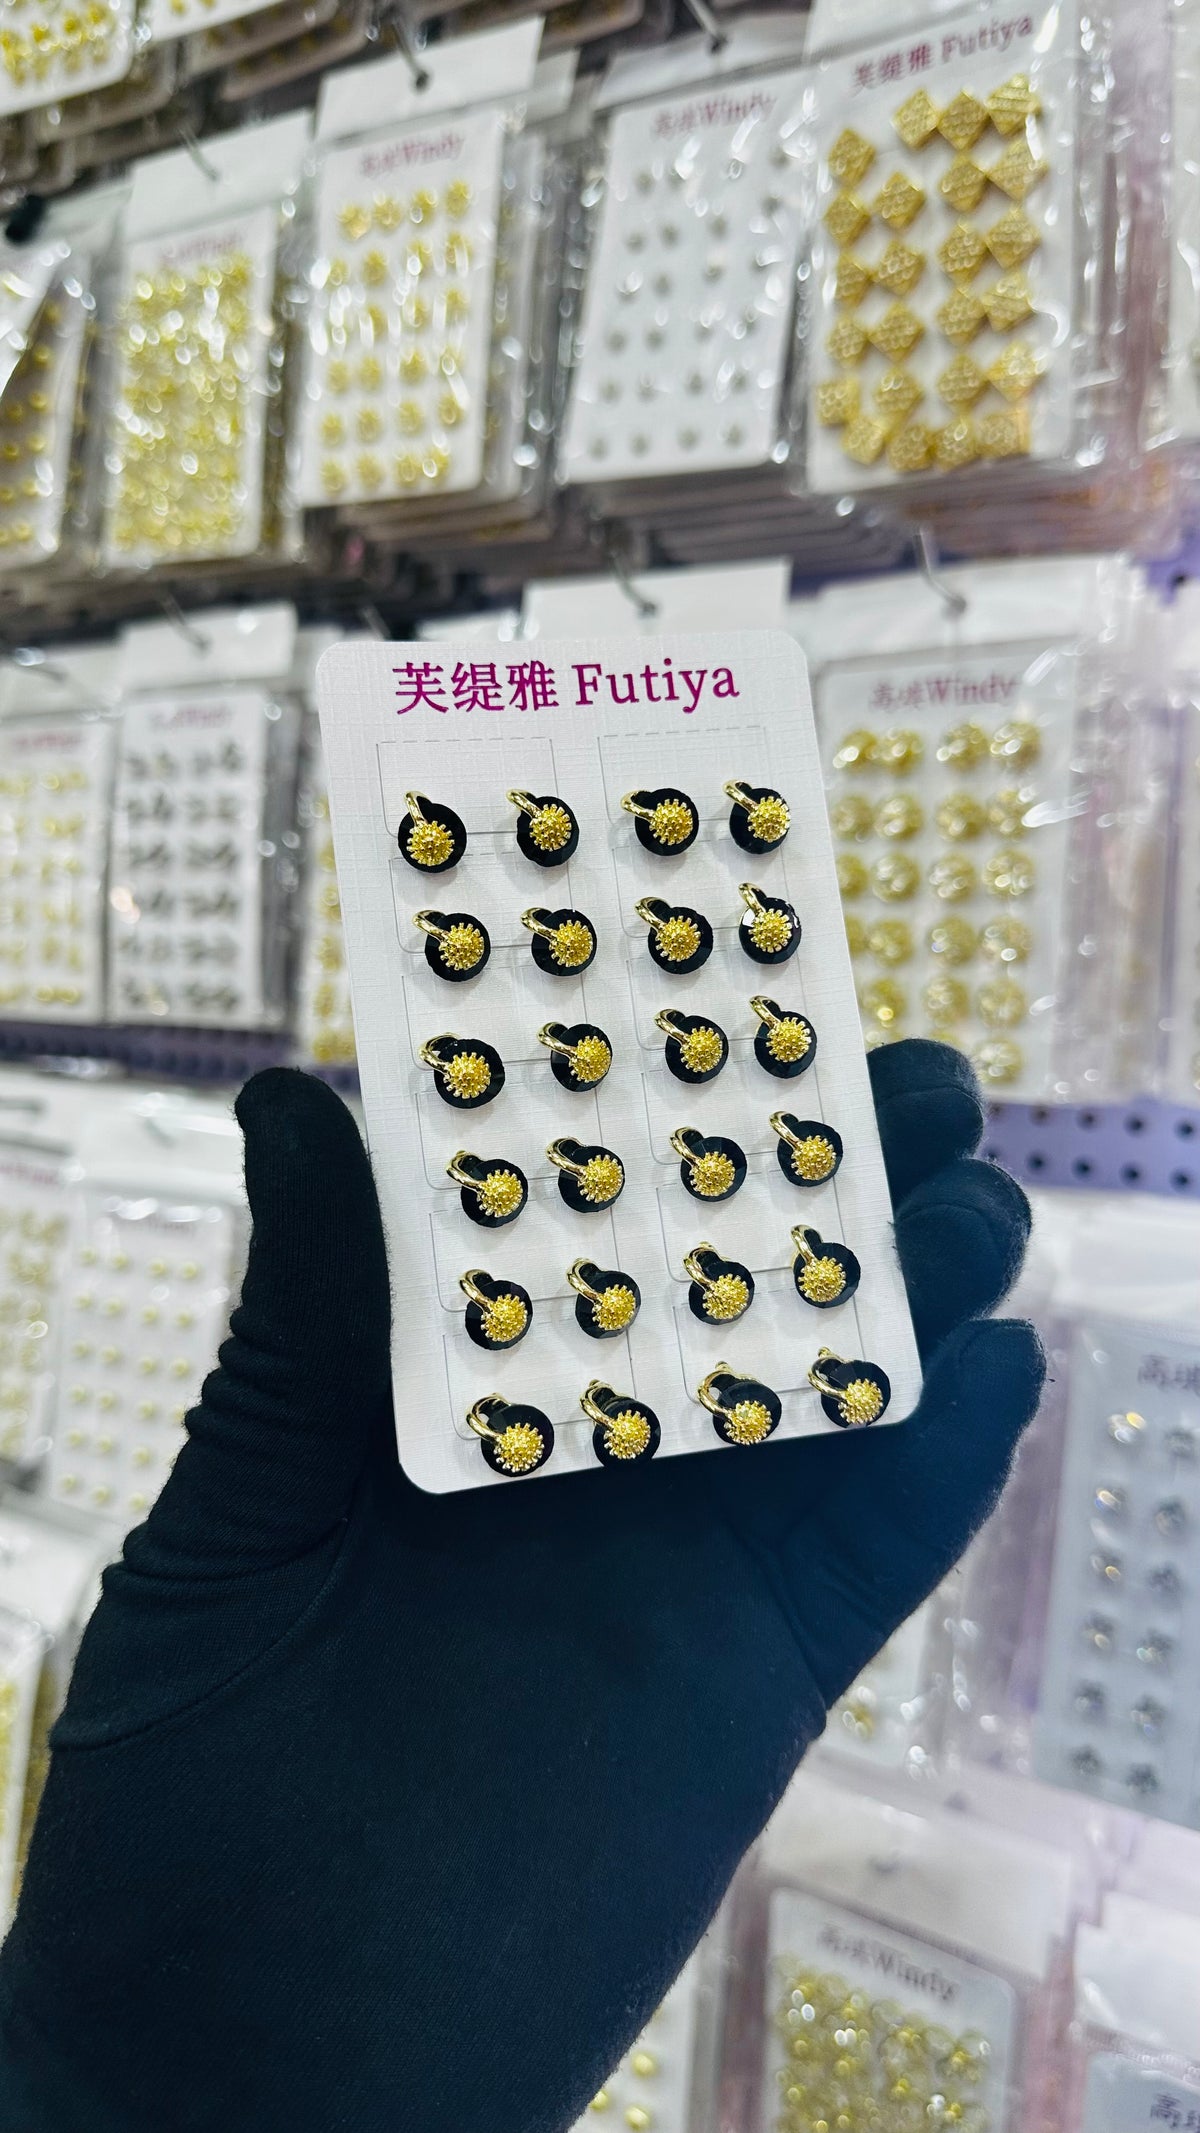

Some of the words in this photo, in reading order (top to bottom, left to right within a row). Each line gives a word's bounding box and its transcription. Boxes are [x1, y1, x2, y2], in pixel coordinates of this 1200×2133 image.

[392, 660, 559, 715] 芙缇雅
[571, 657, 740, 714] Futiya
